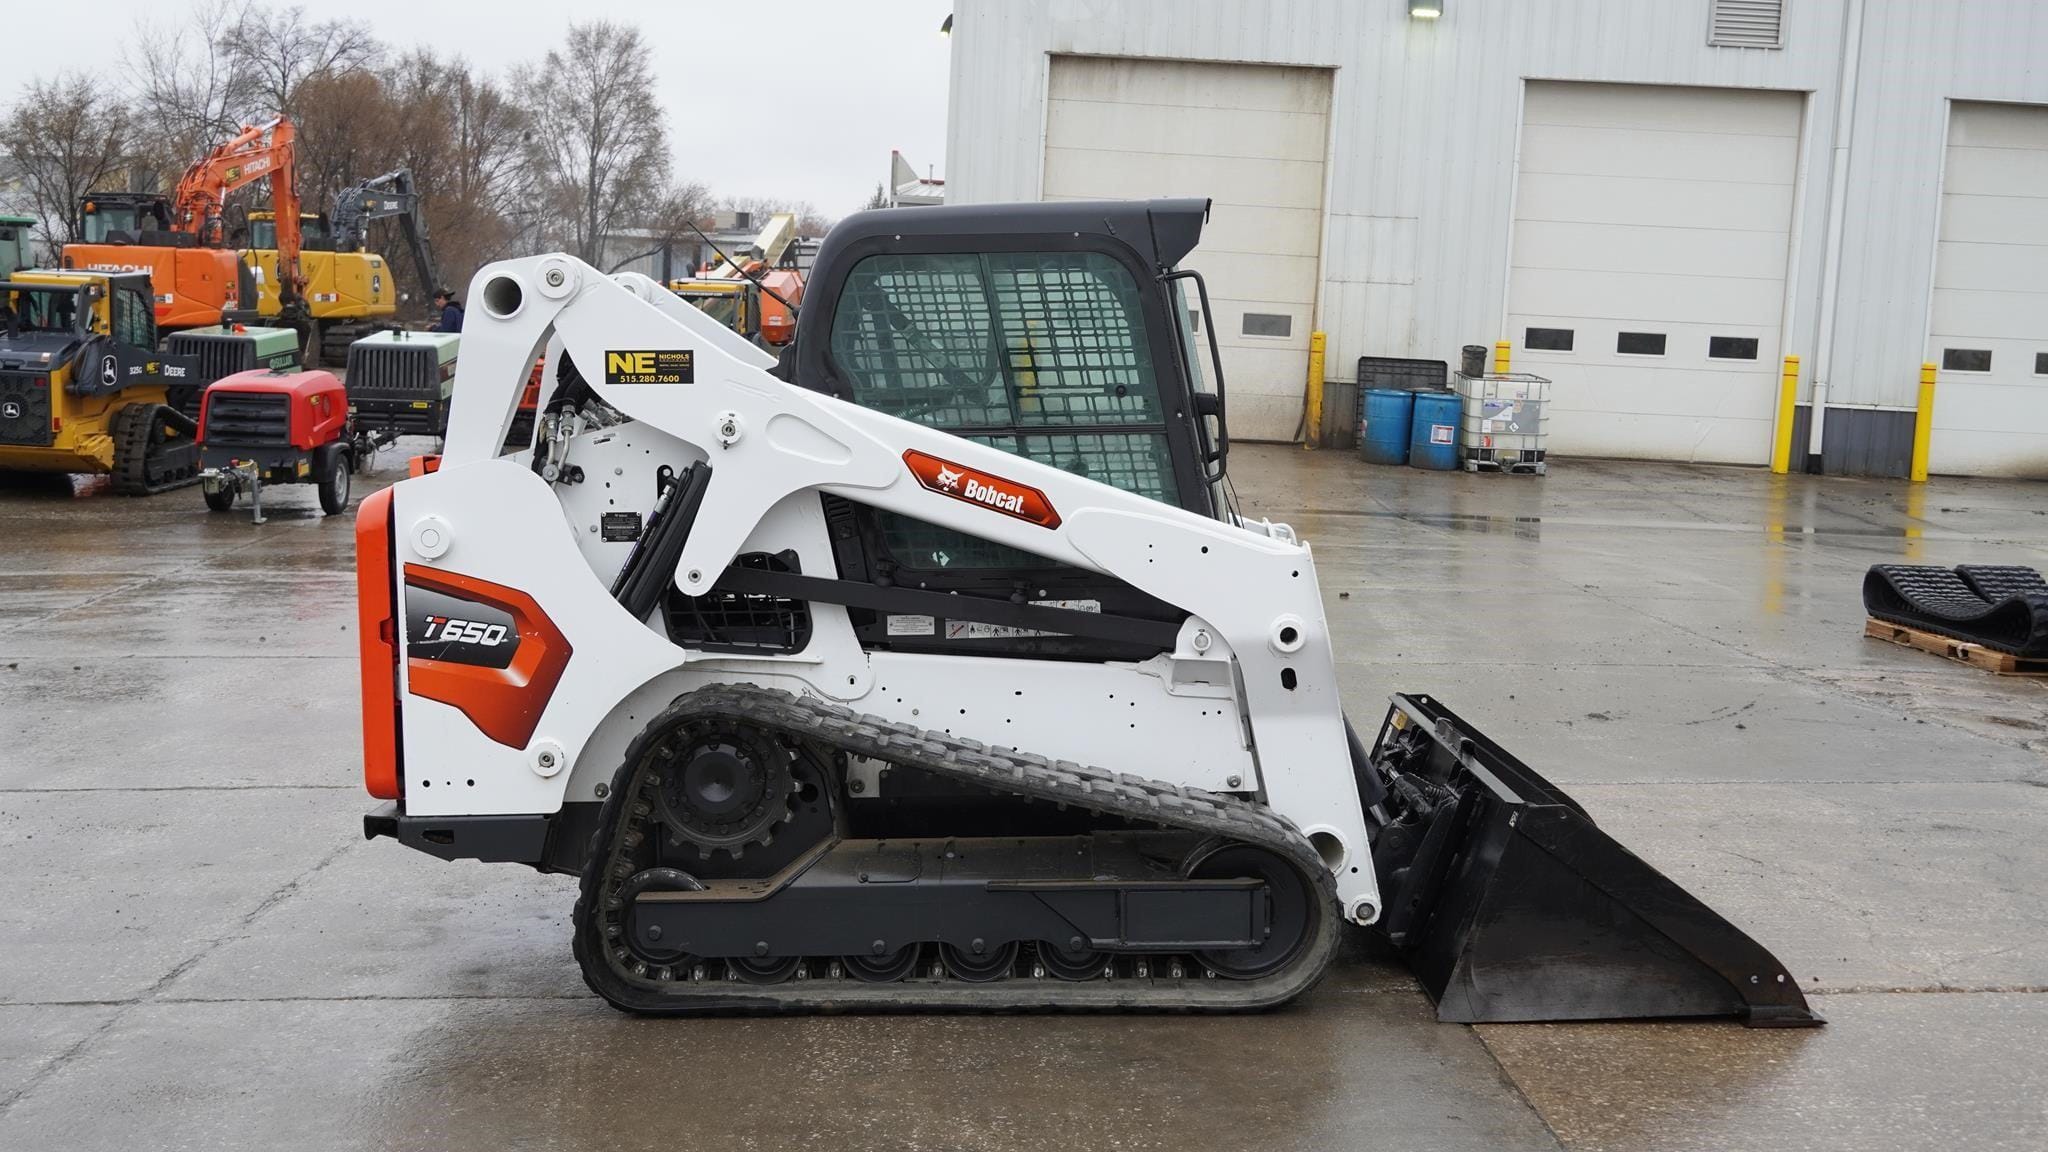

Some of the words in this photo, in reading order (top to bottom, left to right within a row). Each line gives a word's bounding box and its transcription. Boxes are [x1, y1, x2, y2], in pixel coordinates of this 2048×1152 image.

[243, 156, 271, 175] HITACHI
[383, 201, 399, 210] DEERE
[129, 366, 143, 375] 325G
[164, 364, 186, 377] DEERE
[608, 353, 656, 374] NE
[620, 375, 680, 383] 515.280.7600
[964, 478, 1024, 514] Bobcat
[424, 616, 505, 646] T650
